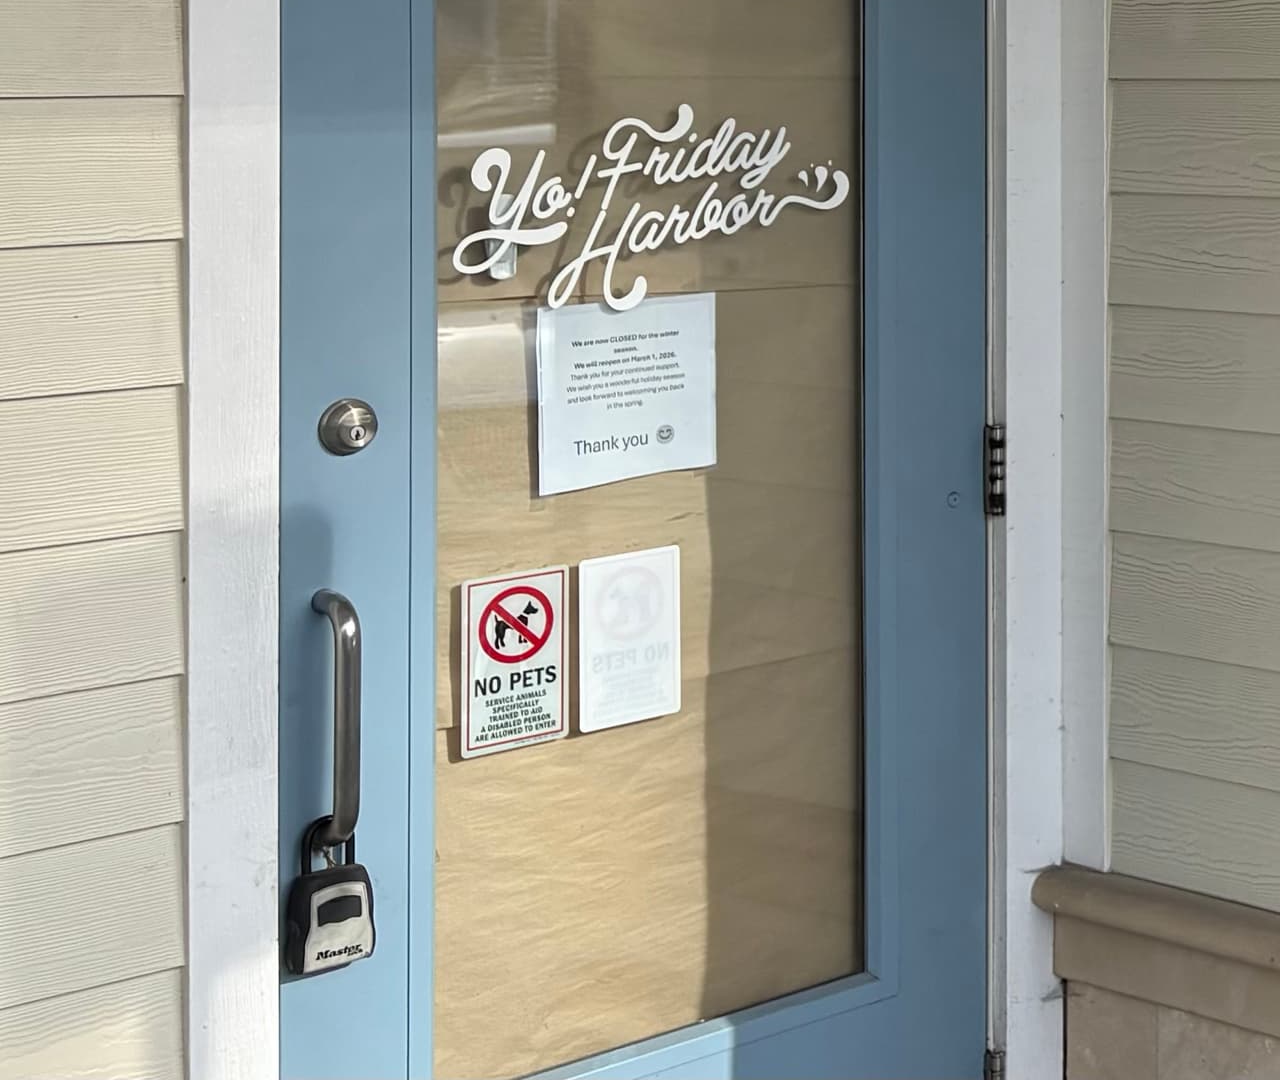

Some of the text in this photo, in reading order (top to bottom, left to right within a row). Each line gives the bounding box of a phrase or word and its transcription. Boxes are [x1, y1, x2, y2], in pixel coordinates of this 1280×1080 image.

[597, 103, 791, 211] Friday
[452, 147, 598, 275] Yo!
[547, 181, 850, 312] Harbor
[610, 334, 637, 343] CLOSED
[574, 433, 649, 457] Thank you
[475, 665, 556, 698] NO PETS
[485, 689, 547, 707] SERVICE ANIMALS
[492, 699, 540, 714] SPECIFICALLY
[488, 719, 522, 732] DISABLED
[523, 713, 551, 724] PERSON
[489, 711, 519, 723] TRAINED
[521, 709, 529, 717] TO
[475, 733, 488, 742] ARE
[490, 726, 523, 739] ALLOWED
[525, 725, 533, 733] TO
[315, 943, 362, 961] Master
